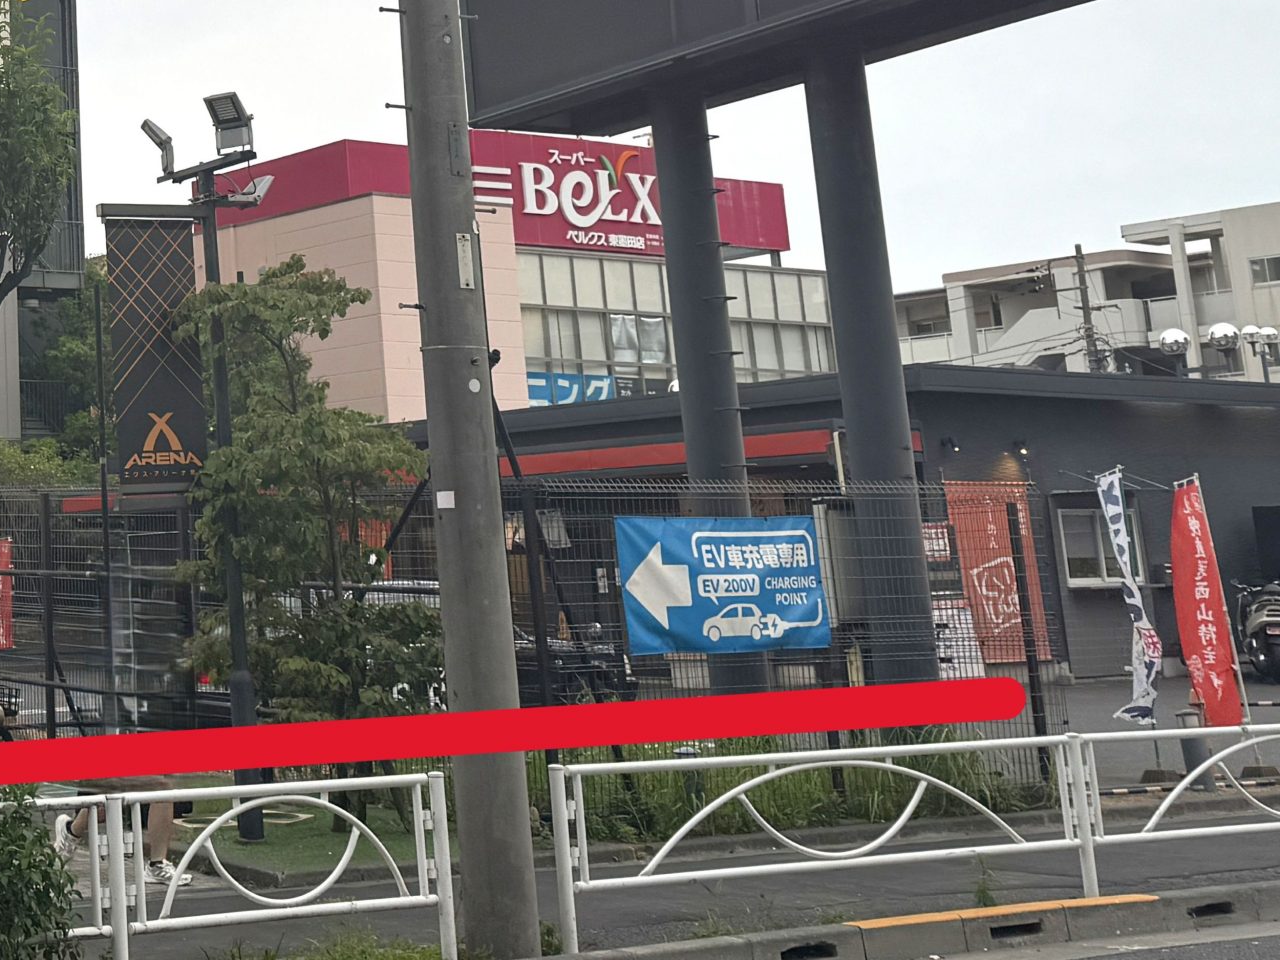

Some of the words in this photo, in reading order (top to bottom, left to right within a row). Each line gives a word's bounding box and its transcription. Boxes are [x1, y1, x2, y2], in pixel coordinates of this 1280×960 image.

[548, 149, 596, 167] スーパー
[566, 230, 608, 247] ベルクス
[124, 450, 203, 469] ARENA
[701, 542, 809, 569] EV車充電専用
[703, 578, 720, 594] EV
[723, 577, 757, 594] 200V
[765, 576, 817, 590] CHARGING
[775, 592, 809, 606] POINT
